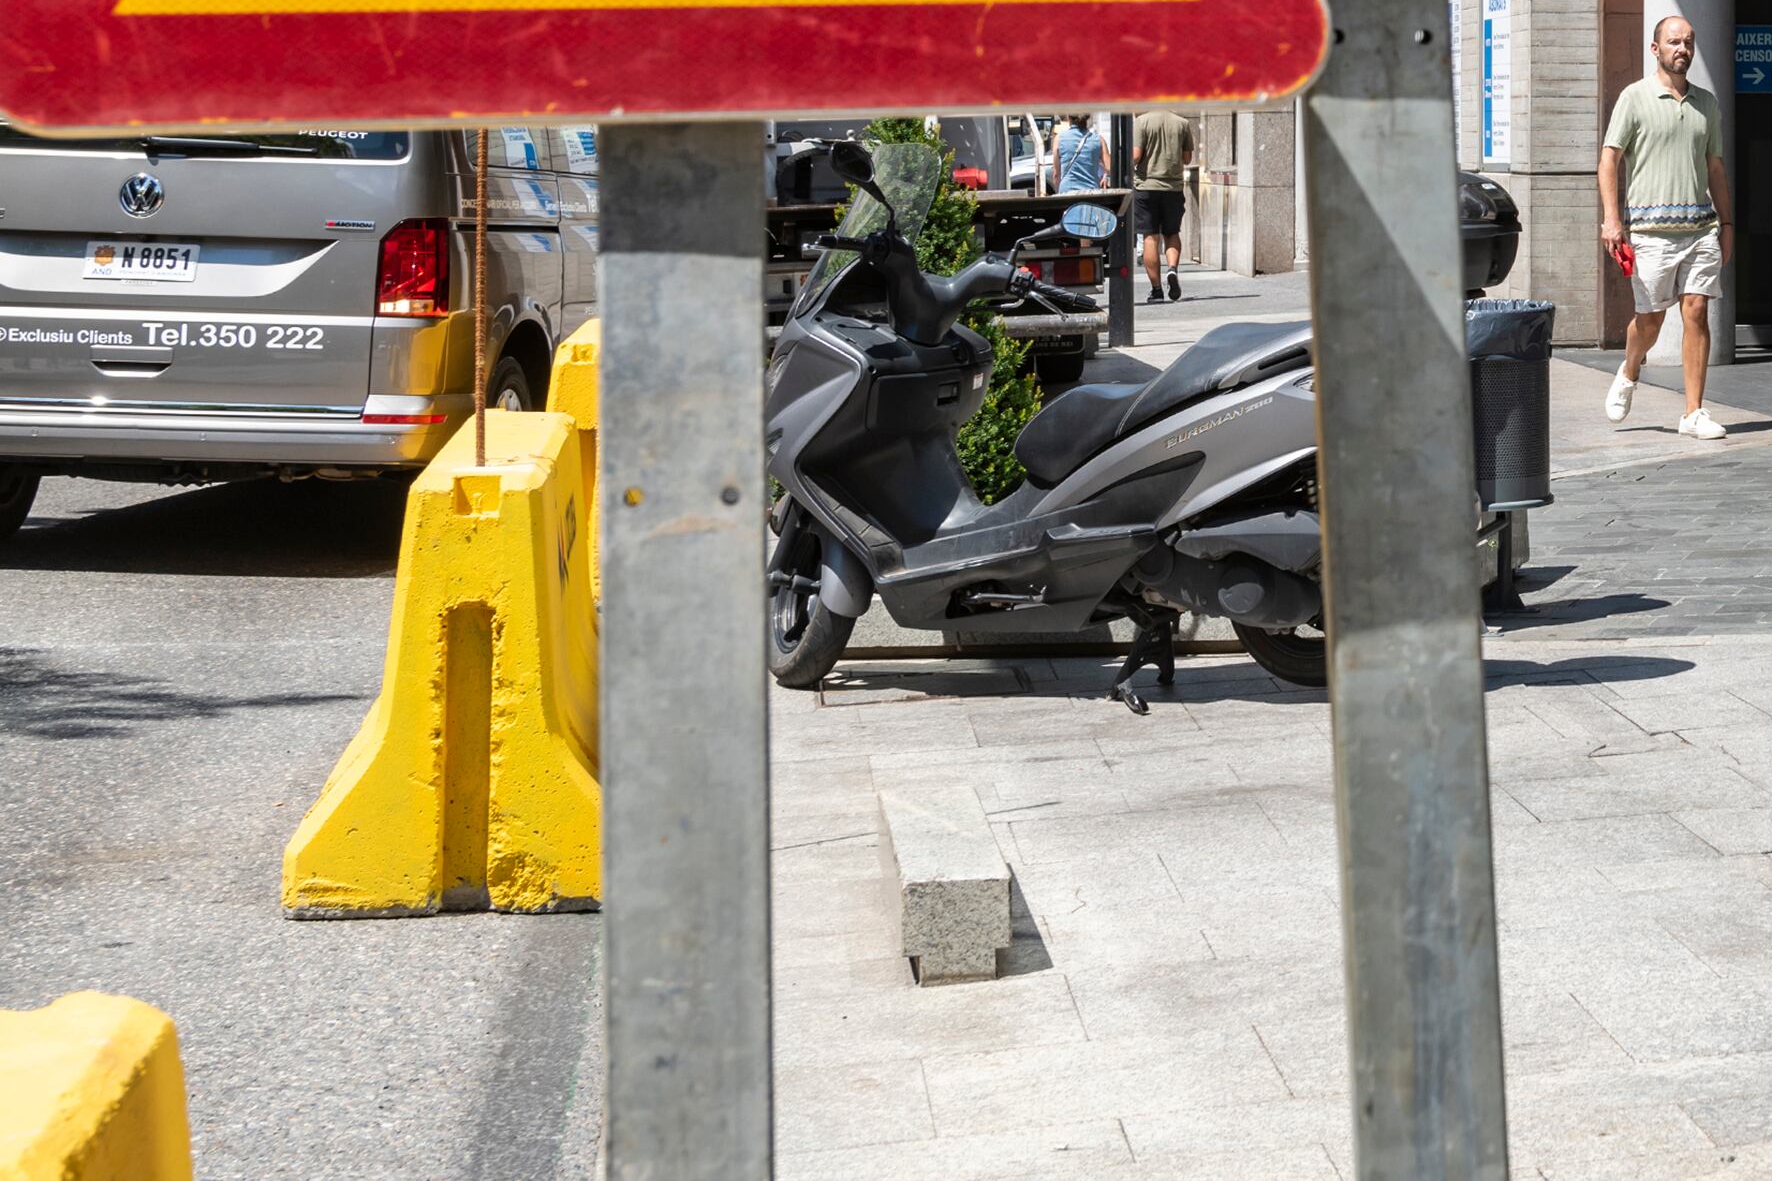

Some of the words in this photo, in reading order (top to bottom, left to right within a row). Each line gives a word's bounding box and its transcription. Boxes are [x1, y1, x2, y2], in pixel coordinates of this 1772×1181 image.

[299, 129, 368, 139] PEUGEOT
[140, 247, 191, 270] 8851
[8, 328, 73, 343] Exclusiu
[77, 329, 133, 345] Clients
[265, 326, 324, 349] 222
[1166, 407, 1245, 449] BURGMAN
